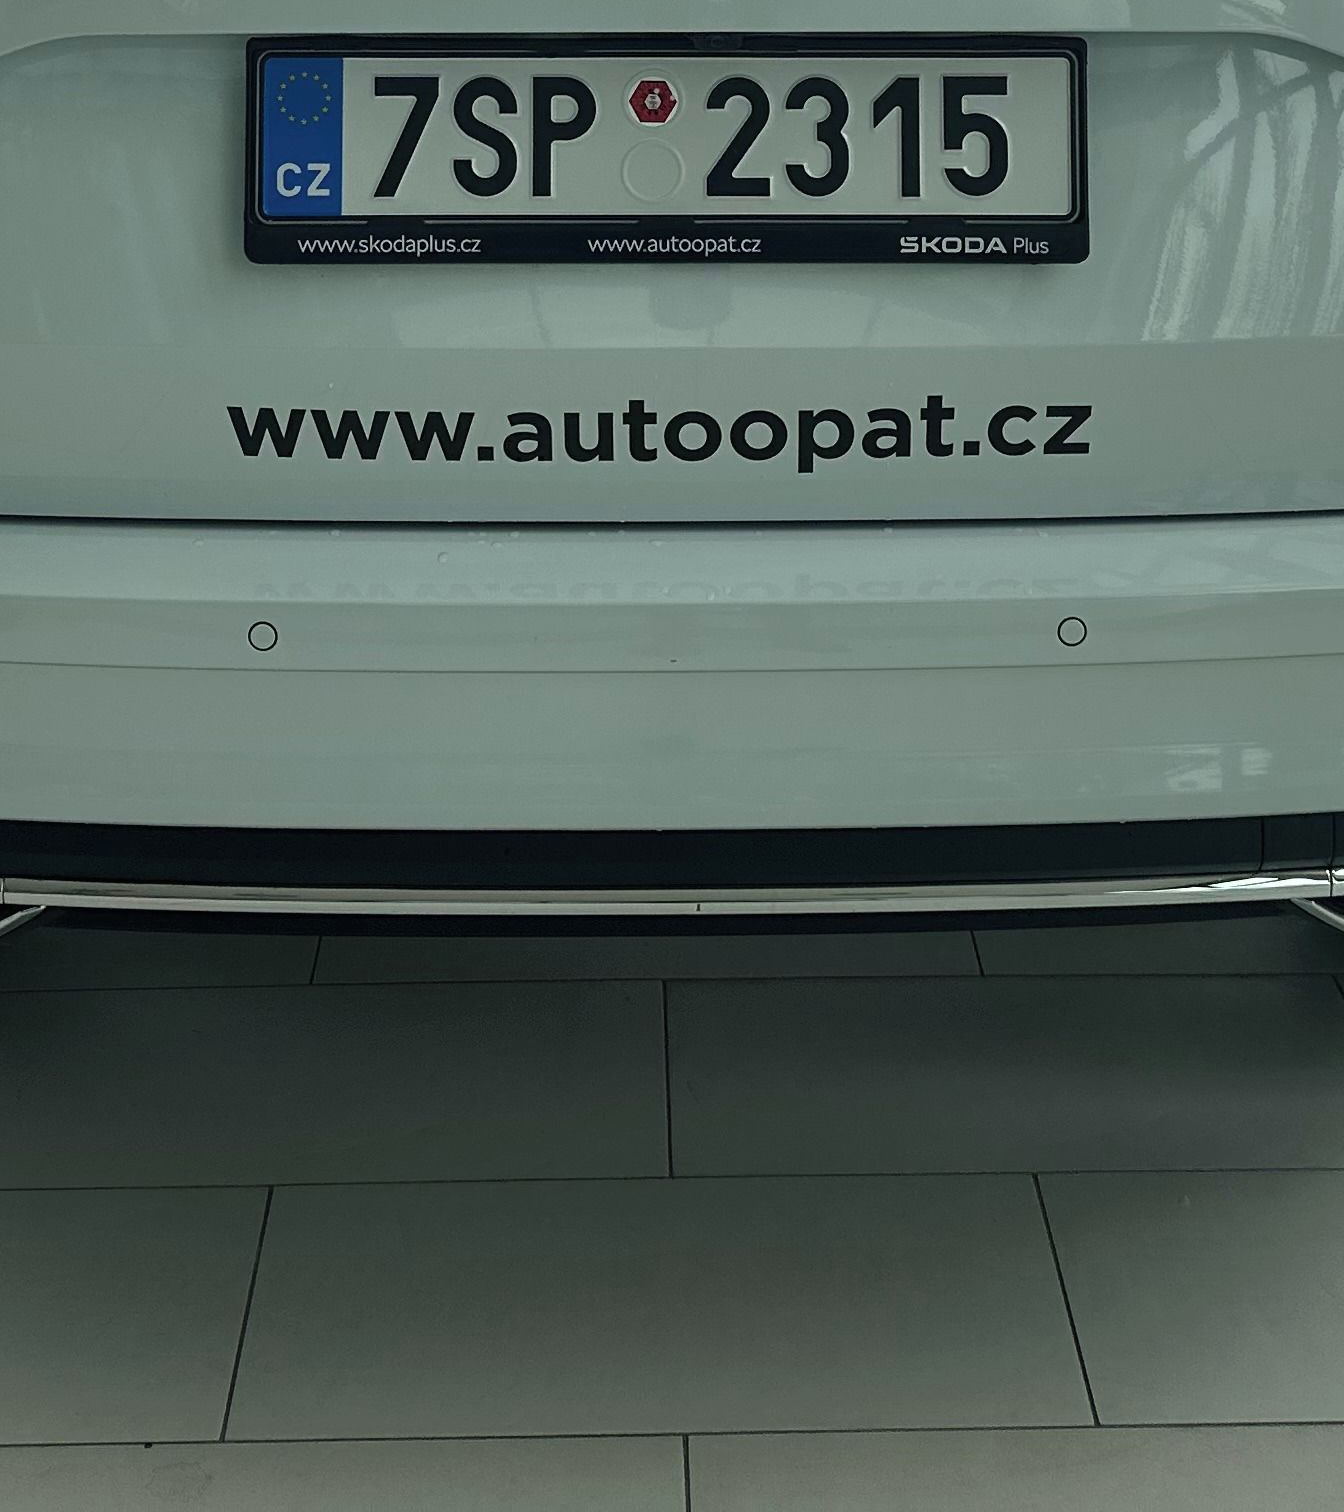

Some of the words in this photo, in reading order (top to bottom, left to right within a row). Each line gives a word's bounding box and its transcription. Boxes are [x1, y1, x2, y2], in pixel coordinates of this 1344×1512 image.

[373, 76, 597, 198] 7SP
[706, 75, 1009, 198] 2315
[276, 162, 331, 198] CZ
[297, 234, 482, 258] www.skodaplus.cz
[587, 235, 762, 257] www.autoopat.cz
[1013, 237, 1050, 255] Plus
[226, 394, 1093, 474] www.autoopat.cz
